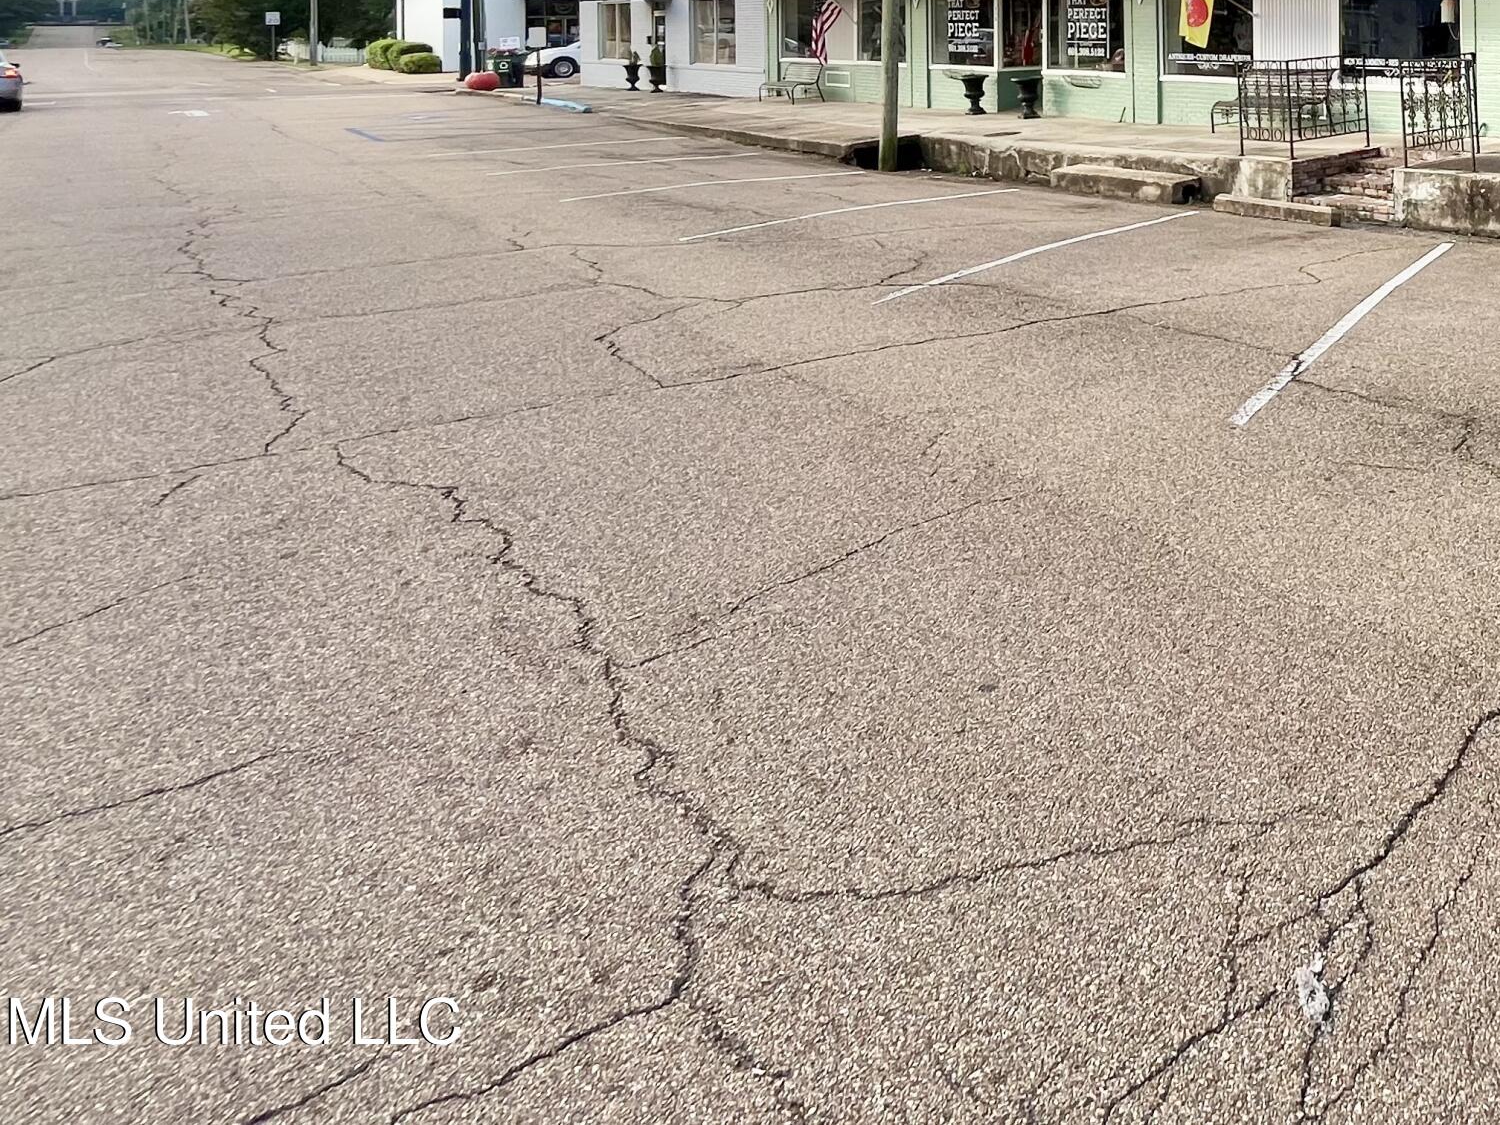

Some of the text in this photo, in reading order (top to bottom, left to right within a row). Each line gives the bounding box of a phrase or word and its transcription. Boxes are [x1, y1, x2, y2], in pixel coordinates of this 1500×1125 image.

[948, 9, 980, 21] PERFECT
[1067, 7, 1107, 19] PERFECT
[948, 22, 980, 37] PIECE
[1067, 22, 1107, 39] PIECE
